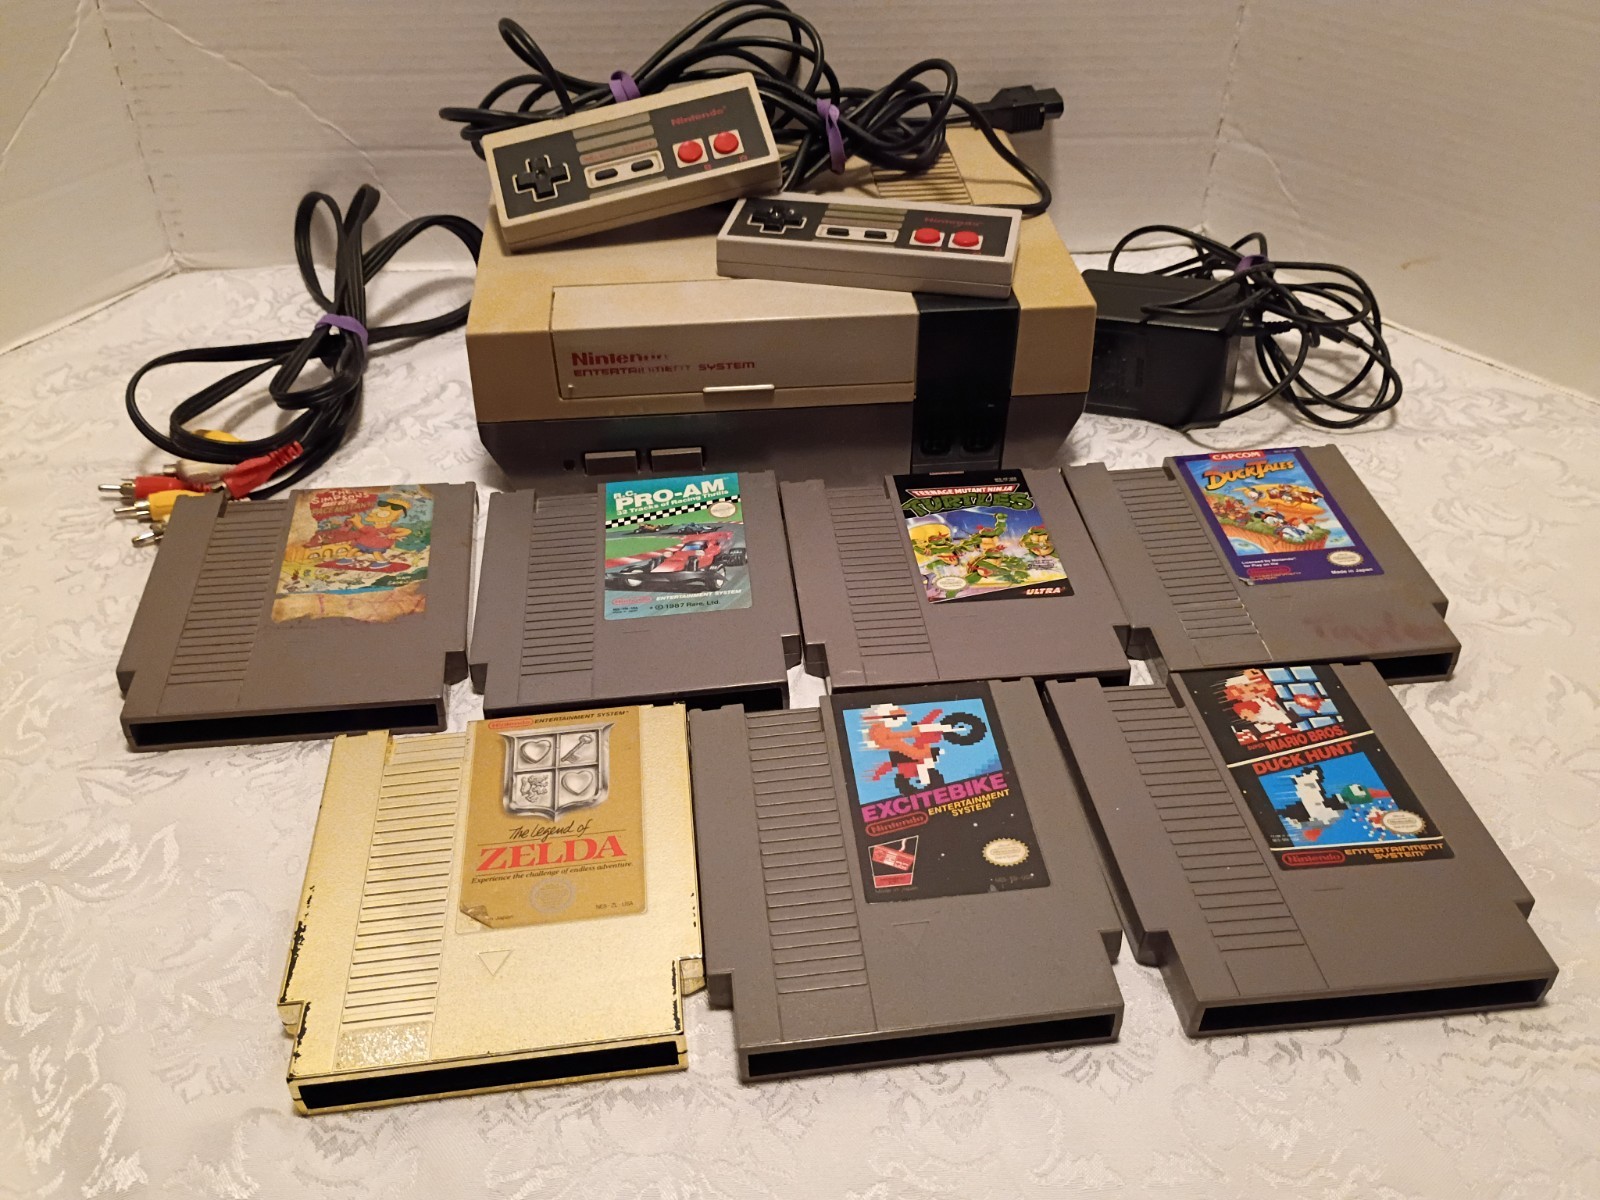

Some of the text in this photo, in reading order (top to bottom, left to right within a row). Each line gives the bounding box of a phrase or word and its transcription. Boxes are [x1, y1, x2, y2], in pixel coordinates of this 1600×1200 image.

[671, 108, 724, 126] Nintendo
[698, 361, 755, 371] SYSTEM
[1212, 451, 1260, 460] CAPCOM
[615, 478, 725, 511] PRO-AM
[912, 485, 1013, 497] TEENAGE MUTANT NINJA
[630, 504, 659, 513] Tracks
[671, 495, 702, 505] Racing
[703, 490, 729, 498] Thrills
[901, 492, 1034, 517] TURTLES
[656, 592, 713, 601] ENTERTAINMENT
[1026, 587, 1061, 595] ULTRA
[534, 714, 595, 724] ENTERTAINMENT
[1264, 734, 1308, 753] MARIO
[1307, 725, 1348, 742] BROS.
[1252, 741, 1354, 775] DUCK HUNT
[861, 773, 1008, 823] EXCITEBIKE
[870, 788, 1011, 834] Nintendo ENTERTAINMENT
[951, 801, 992, 817] SYSTEM
[509, 819, 593, 842] The Legend of
[476, 835, 628, 872] ZELDA
[1287, 843, 1444, 864] Nintendo ENTERTAINMENT
[1373, 850, 1424, 861] SYSTEM
[471, 873, 511, 885] Experience
[513, 872, 525, 880] the
[525, 868, 560, 879] challenge
[561, 867, 570, 875] of
[569, 865, 596, 874] endless
